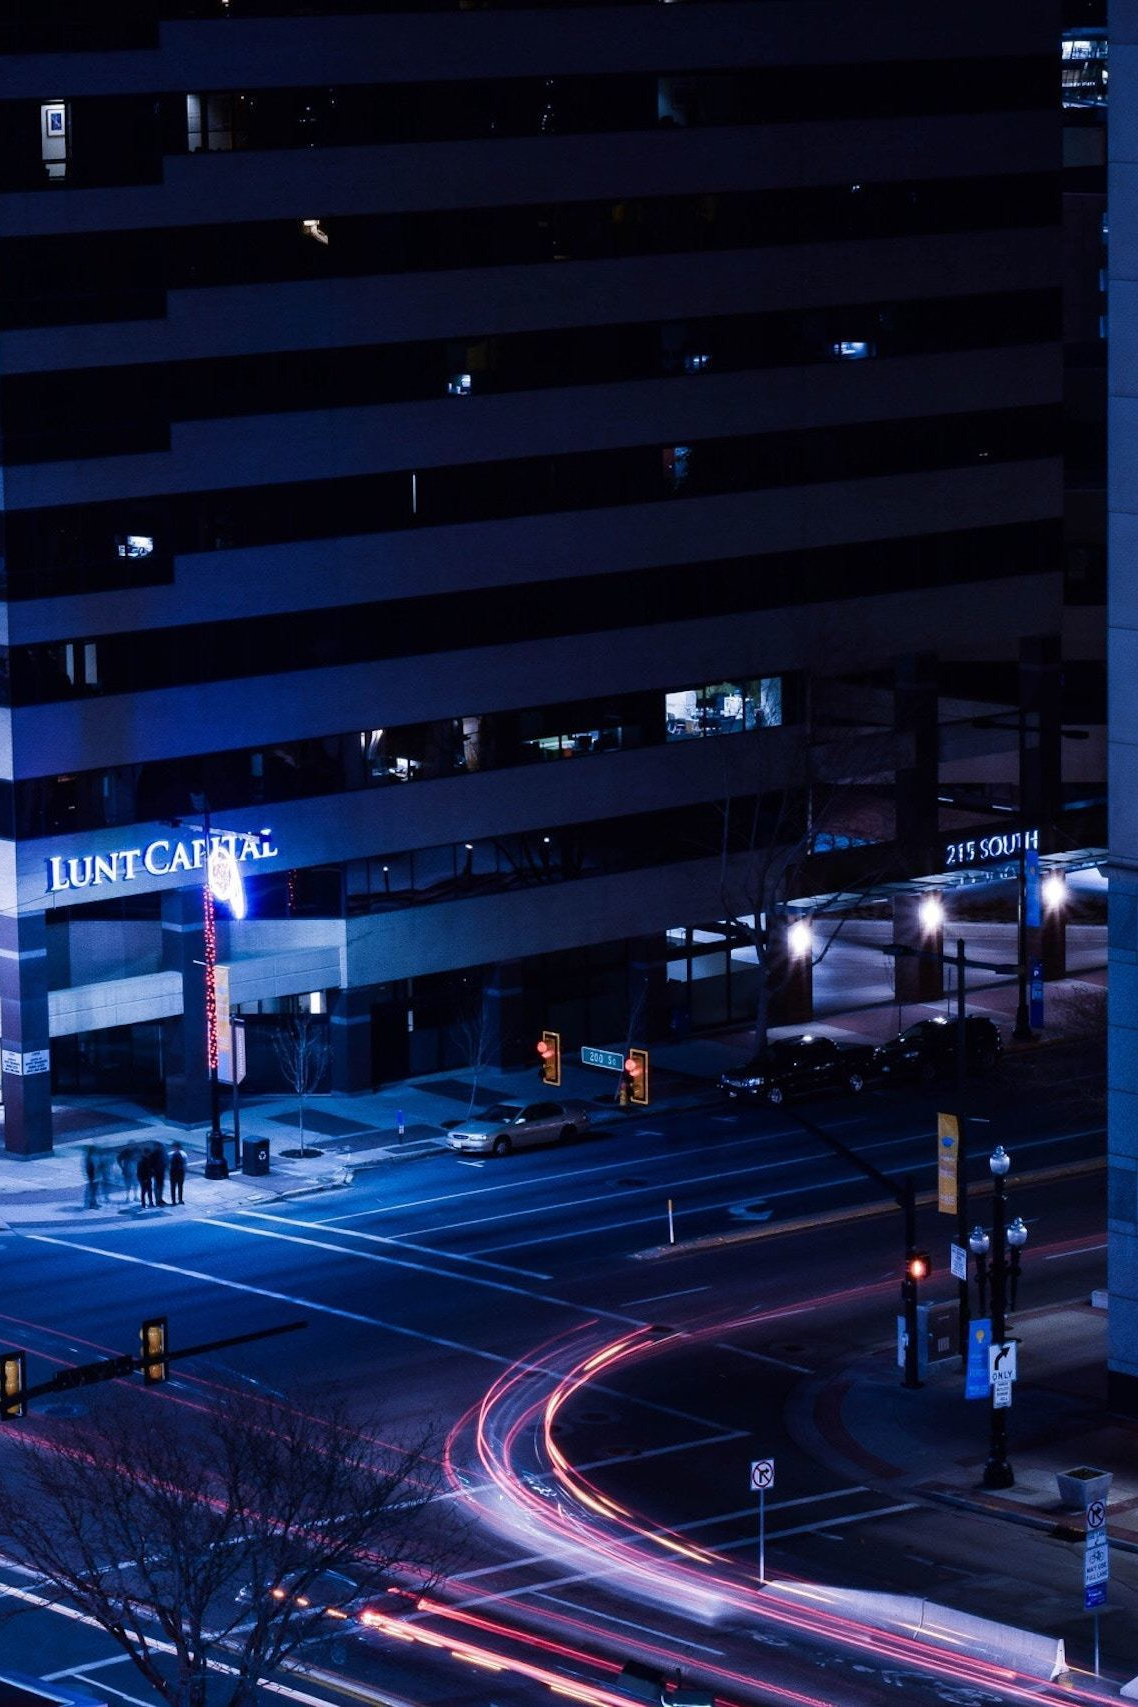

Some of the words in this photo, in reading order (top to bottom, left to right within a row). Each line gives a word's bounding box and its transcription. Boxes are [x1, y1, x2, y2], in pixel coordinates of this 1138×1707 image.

[946, 841, 976, 864] 215
[980, 830, 1039, 859] SOUTH
[50, 849, 141, 891] LUNT
[144, 833, 278, 876] CAPITAL
[590, 1052, 603, 1063] 200
[992, 1370, 1013, 1381] ONLY
